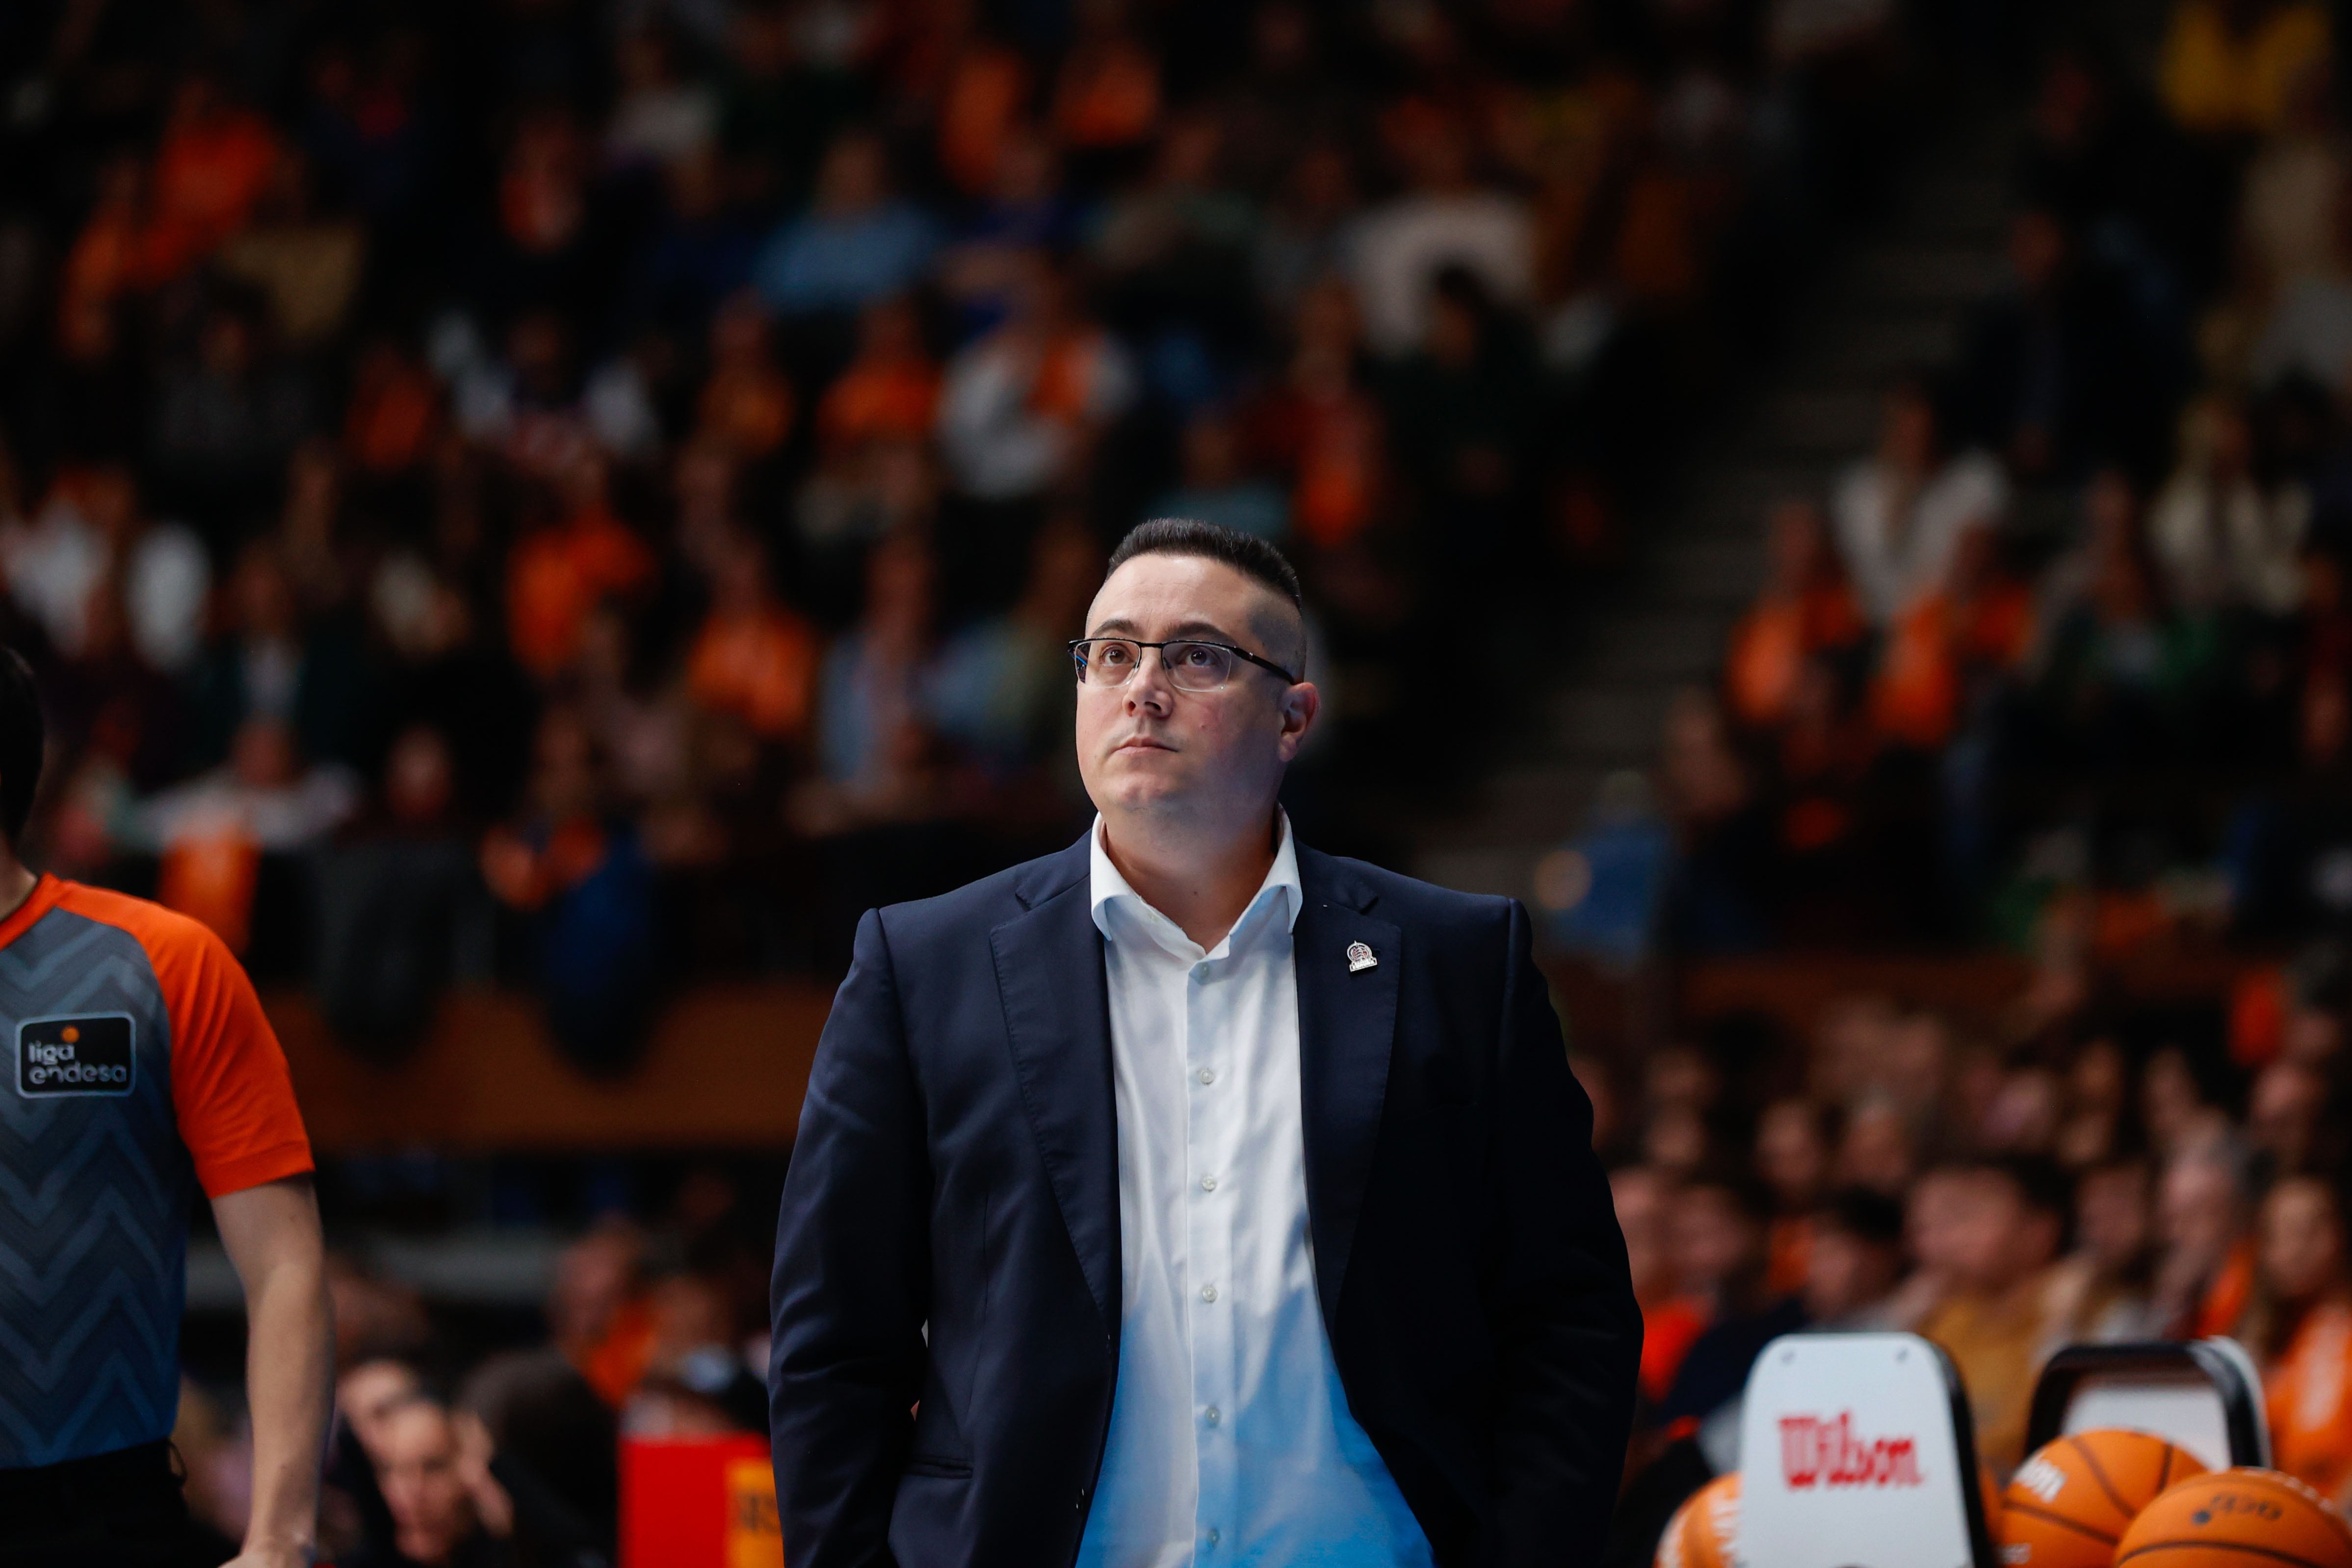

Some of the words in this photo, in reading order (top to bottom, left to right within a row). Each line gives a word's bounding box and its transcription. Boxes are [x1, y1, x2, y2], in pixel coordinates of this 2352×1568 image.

[28, 1040, 75, 1066] liga
[29, 1060, 127, 1085] endesa
[1778, 1411, 1925, 1490] Wilson
